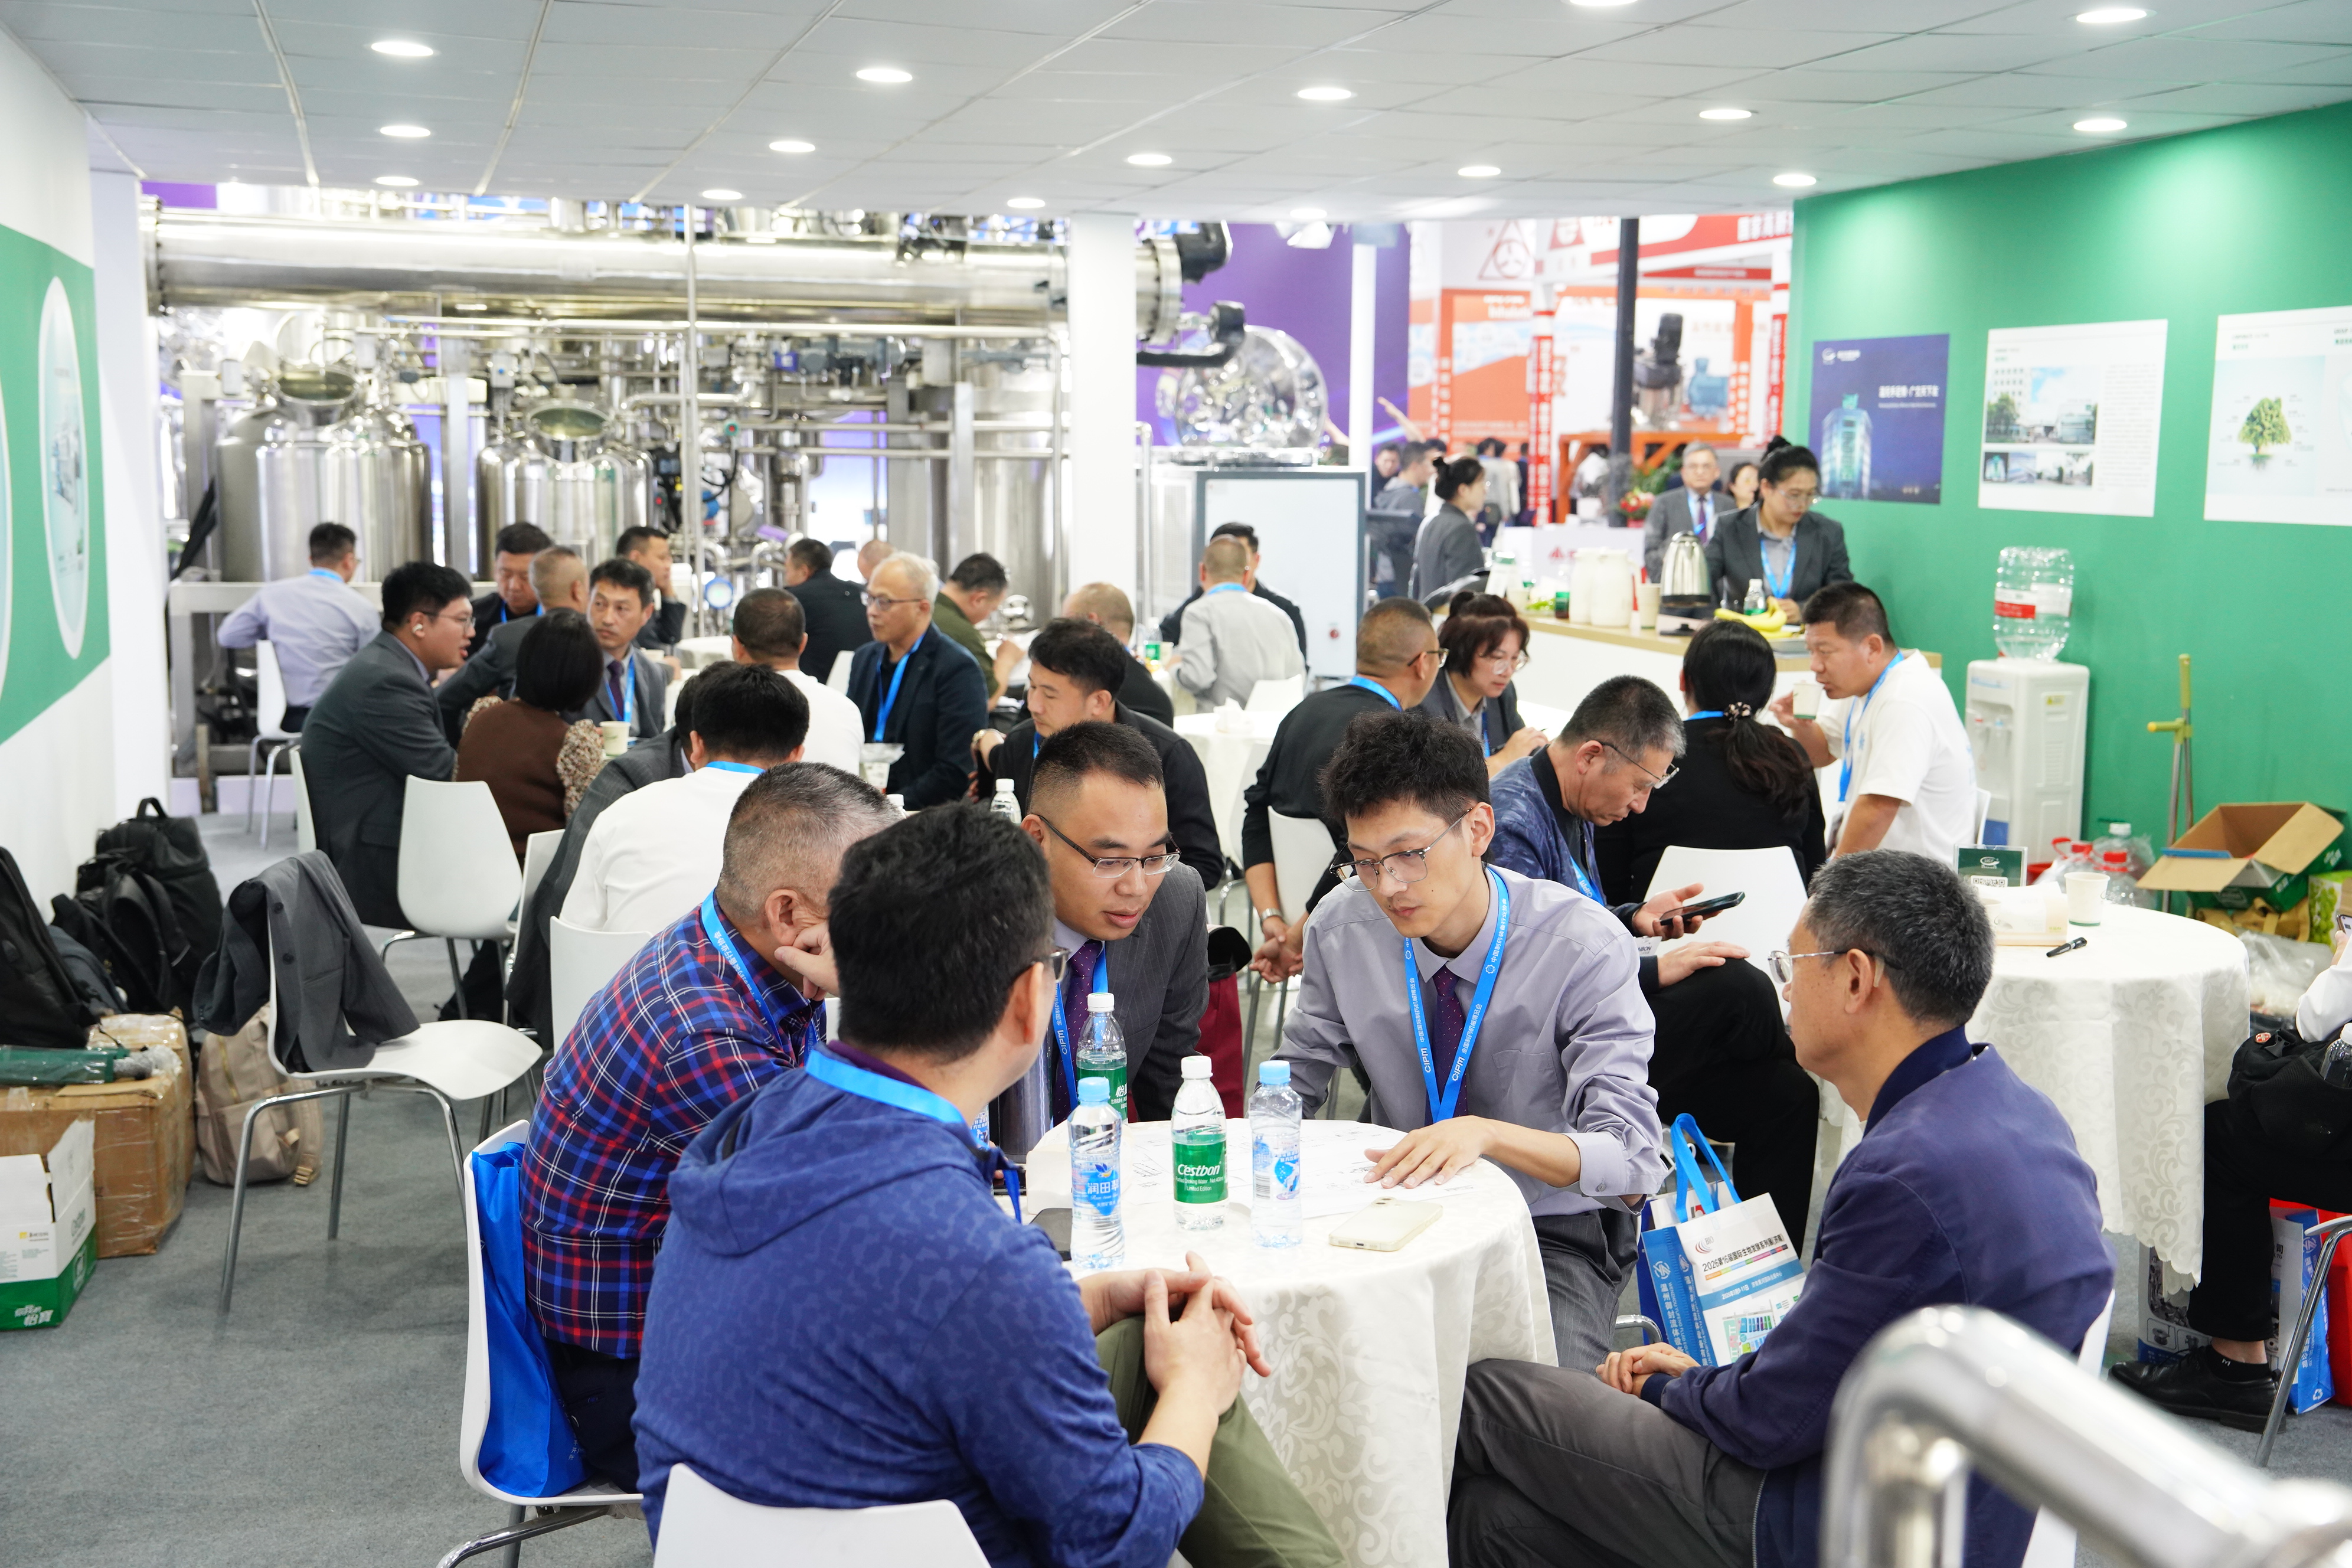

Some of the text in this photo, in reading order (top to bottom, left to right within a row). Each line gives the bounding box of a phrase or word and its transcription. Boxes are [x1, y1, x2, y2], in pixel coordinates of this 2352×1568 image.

[1491, 898, 1507, 963] 中国制药装备行业协会
[1409, 977, 1425, 1042] 中国国际制药机械博览会
[1461, 1003, 1482, 1054] 全国制药机械博览会
[1057, 1030, 1067, 1055] CIPM
[1421, 1047, 1431, 1073] CIPM
[1452, 1056, 1465, 1082] CIPM
[1704, 1236, 1714, 1245] BIO
